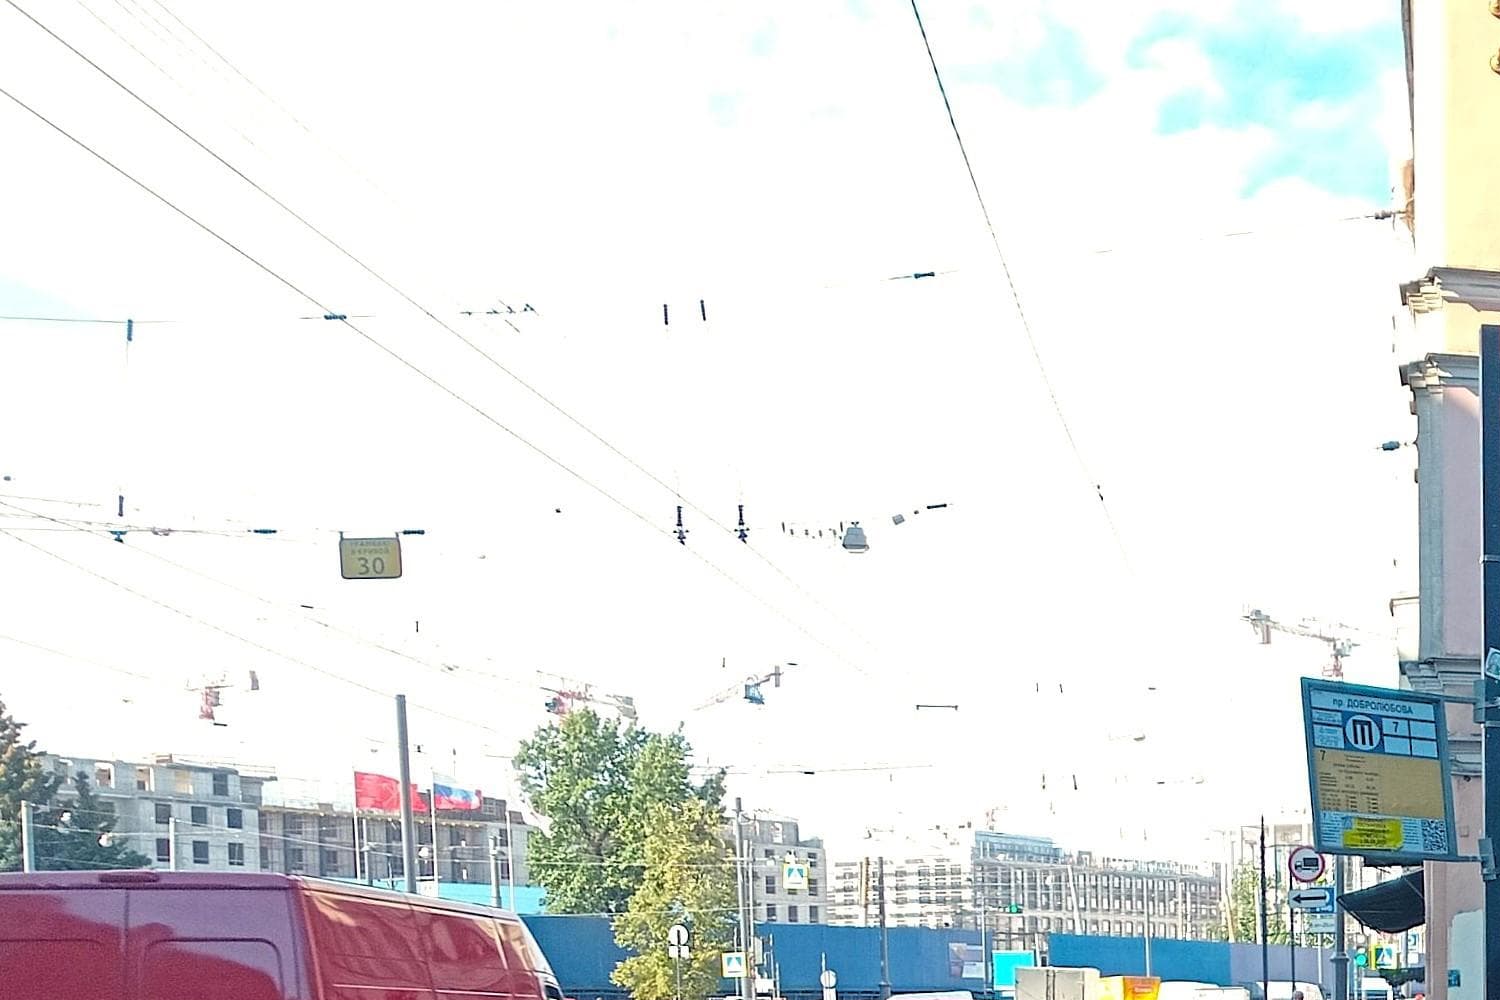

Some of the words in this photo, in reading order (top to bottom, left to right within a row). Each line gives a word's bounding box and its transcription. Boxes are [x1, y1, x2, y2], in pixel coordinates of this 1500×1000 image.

[358, 557, 385, 575] 30
[1347, 699, 1413, 714] ДОБРОЛЮБОВА
[1392, 721, 1399, 733] 7
[1320, 750, 1325, 760] 7
